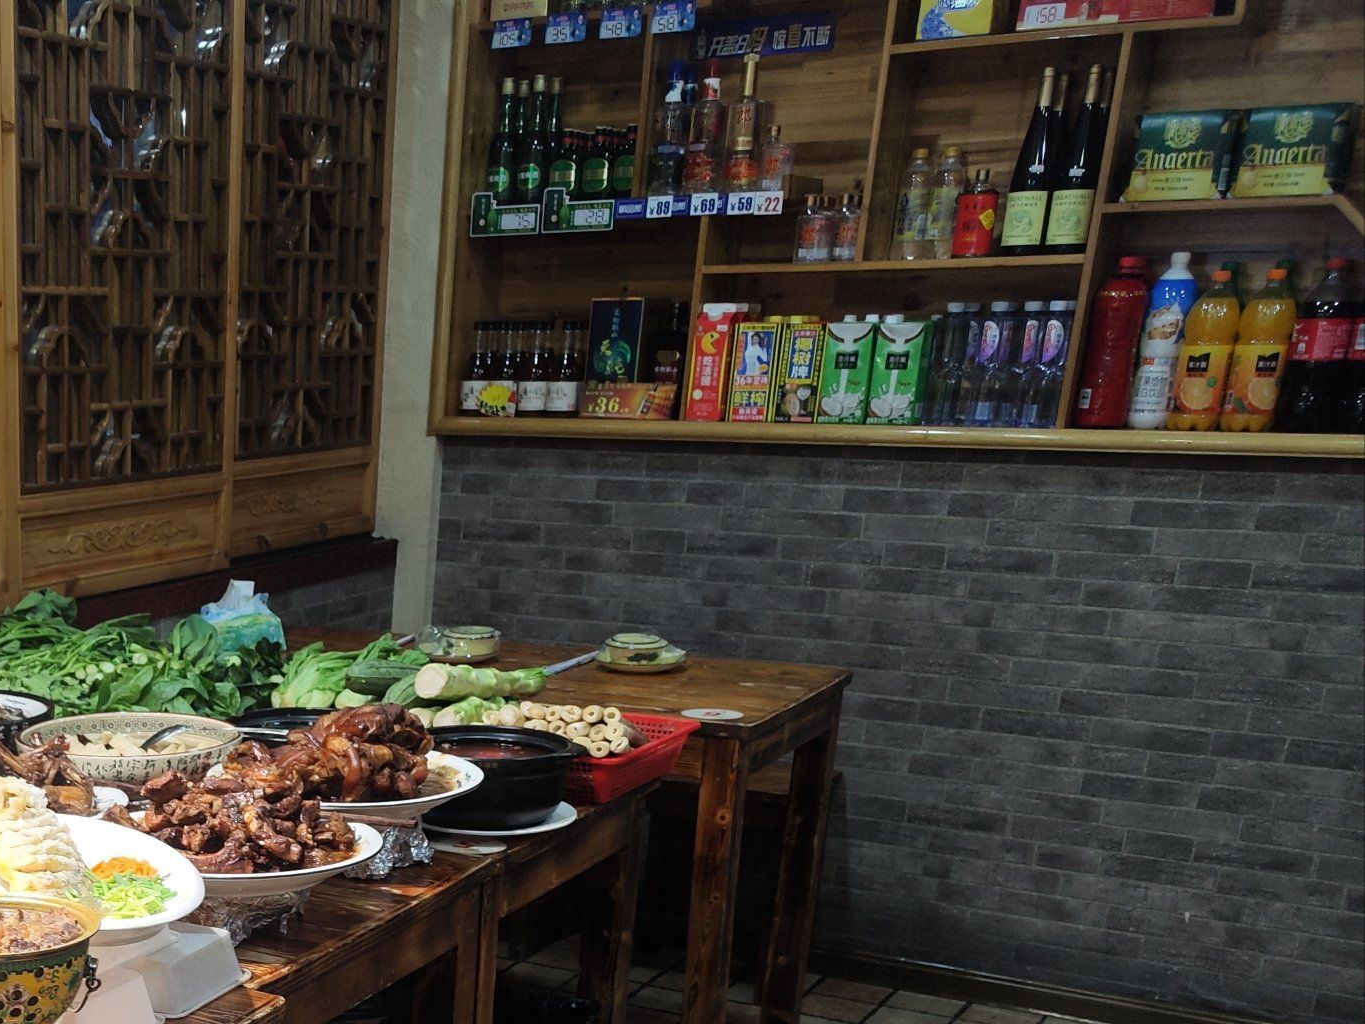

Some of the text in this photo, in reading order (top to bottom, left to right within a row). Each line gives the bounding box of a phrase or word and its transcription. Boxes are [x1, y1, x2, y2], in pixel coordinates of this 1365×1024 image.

[1034, 6, 1056, 23] 158
[605, 22, 623, 36] 48
[658, 17, 676, 32] 58
[498, 32, 516, 46] 105
[552, 27, 568, 42] 35
[708, 23, 831, 57] 开盖扫码 惊喜不断
[756, 197, 780, 213] ¥22
[514, 214, 530, 228] 75
[790, 338, 814, 379] 椰树牌
[587, 397, 620, 413] ¥36
